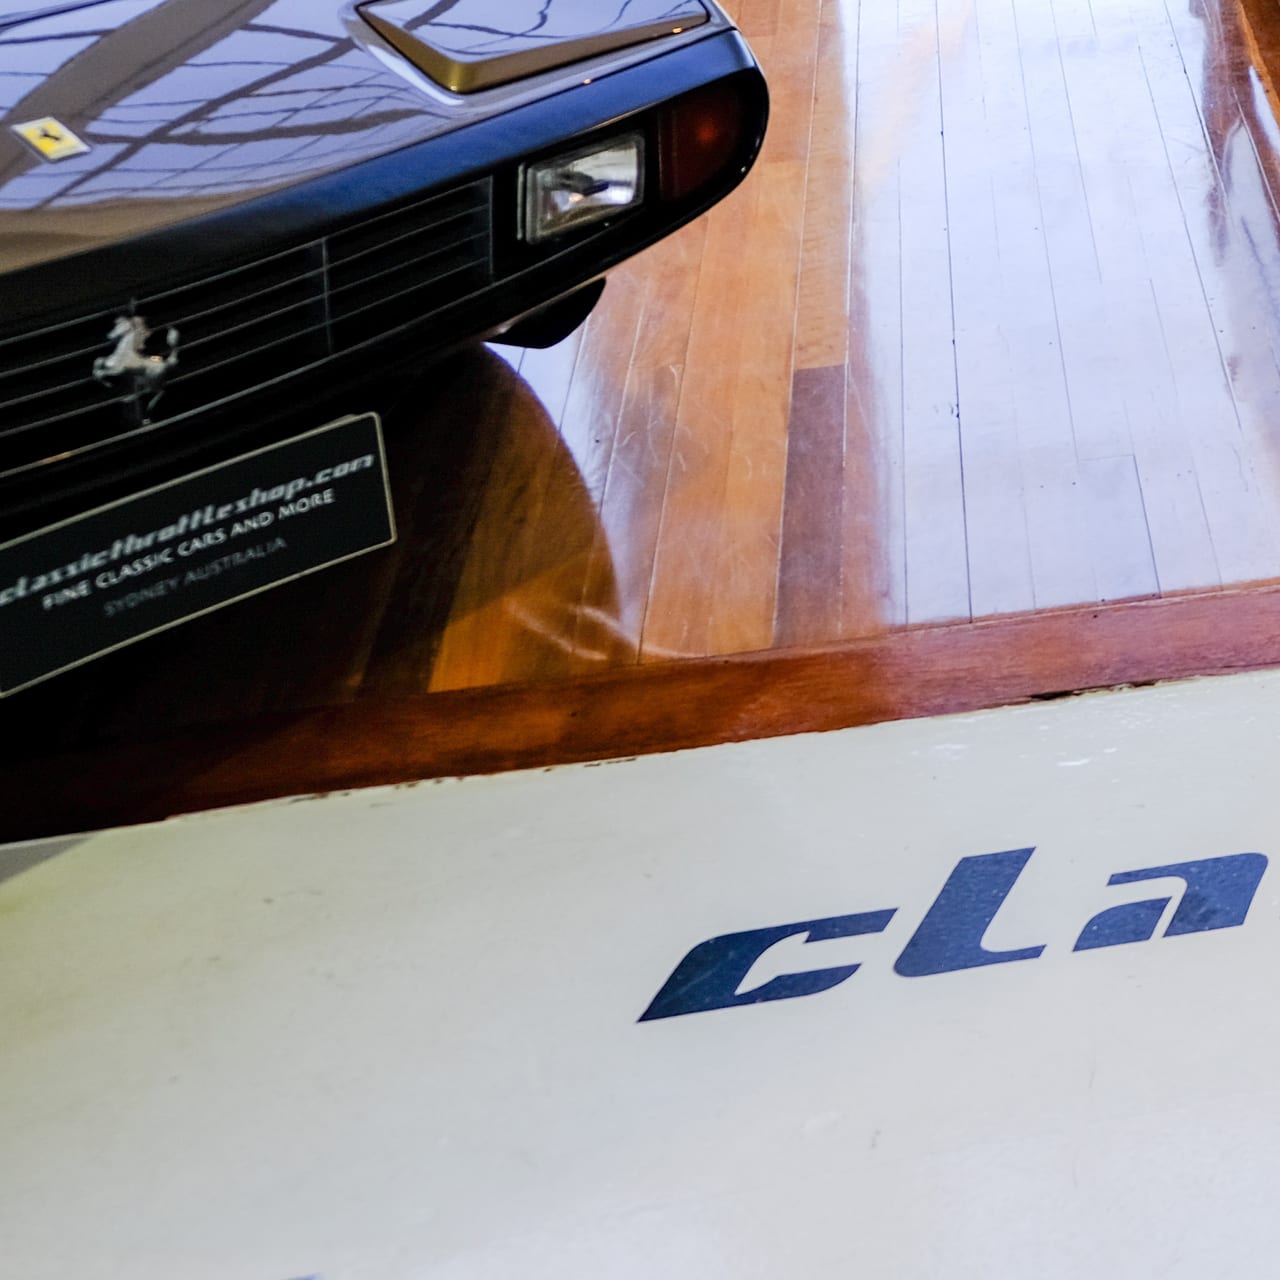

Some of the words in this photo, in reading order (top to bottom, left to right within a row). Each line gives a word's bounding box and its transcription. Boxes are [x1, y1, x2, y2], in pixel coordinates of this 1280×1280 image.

[42, 579, 90, 610] FINE
[95, 548, 175, 589] CLASSIC
[177, 527, 225, 557] CARS
[230, 511, 274, 538] AND
[278, 488, 336, 520] MORE
[104, 577, 179, 617] SYDNEY
[184, 537, 288, 584] AUSTRALIA
